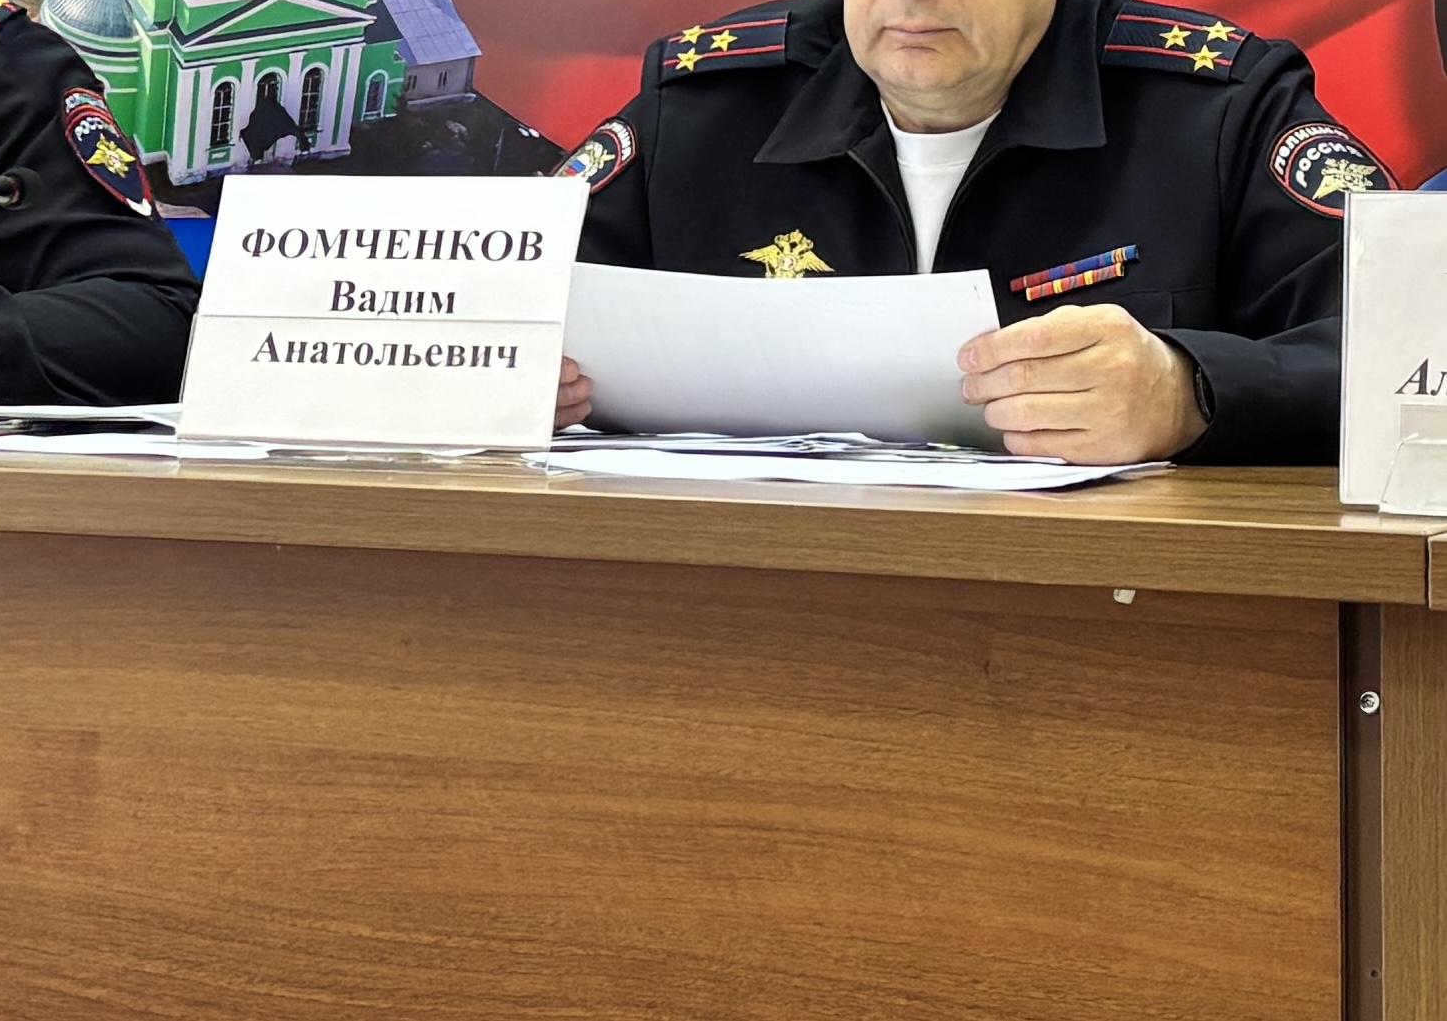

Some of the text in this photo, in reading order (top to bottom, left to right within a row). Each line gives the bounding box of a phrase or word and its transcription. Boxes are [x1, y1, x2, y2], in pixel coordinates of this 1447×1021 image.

[240, 227, 544, 262] ФОМЧЕНКОВ
[329, 279, 457, 316] Вадим
[250, 330, 520, 370] Анатольевич
